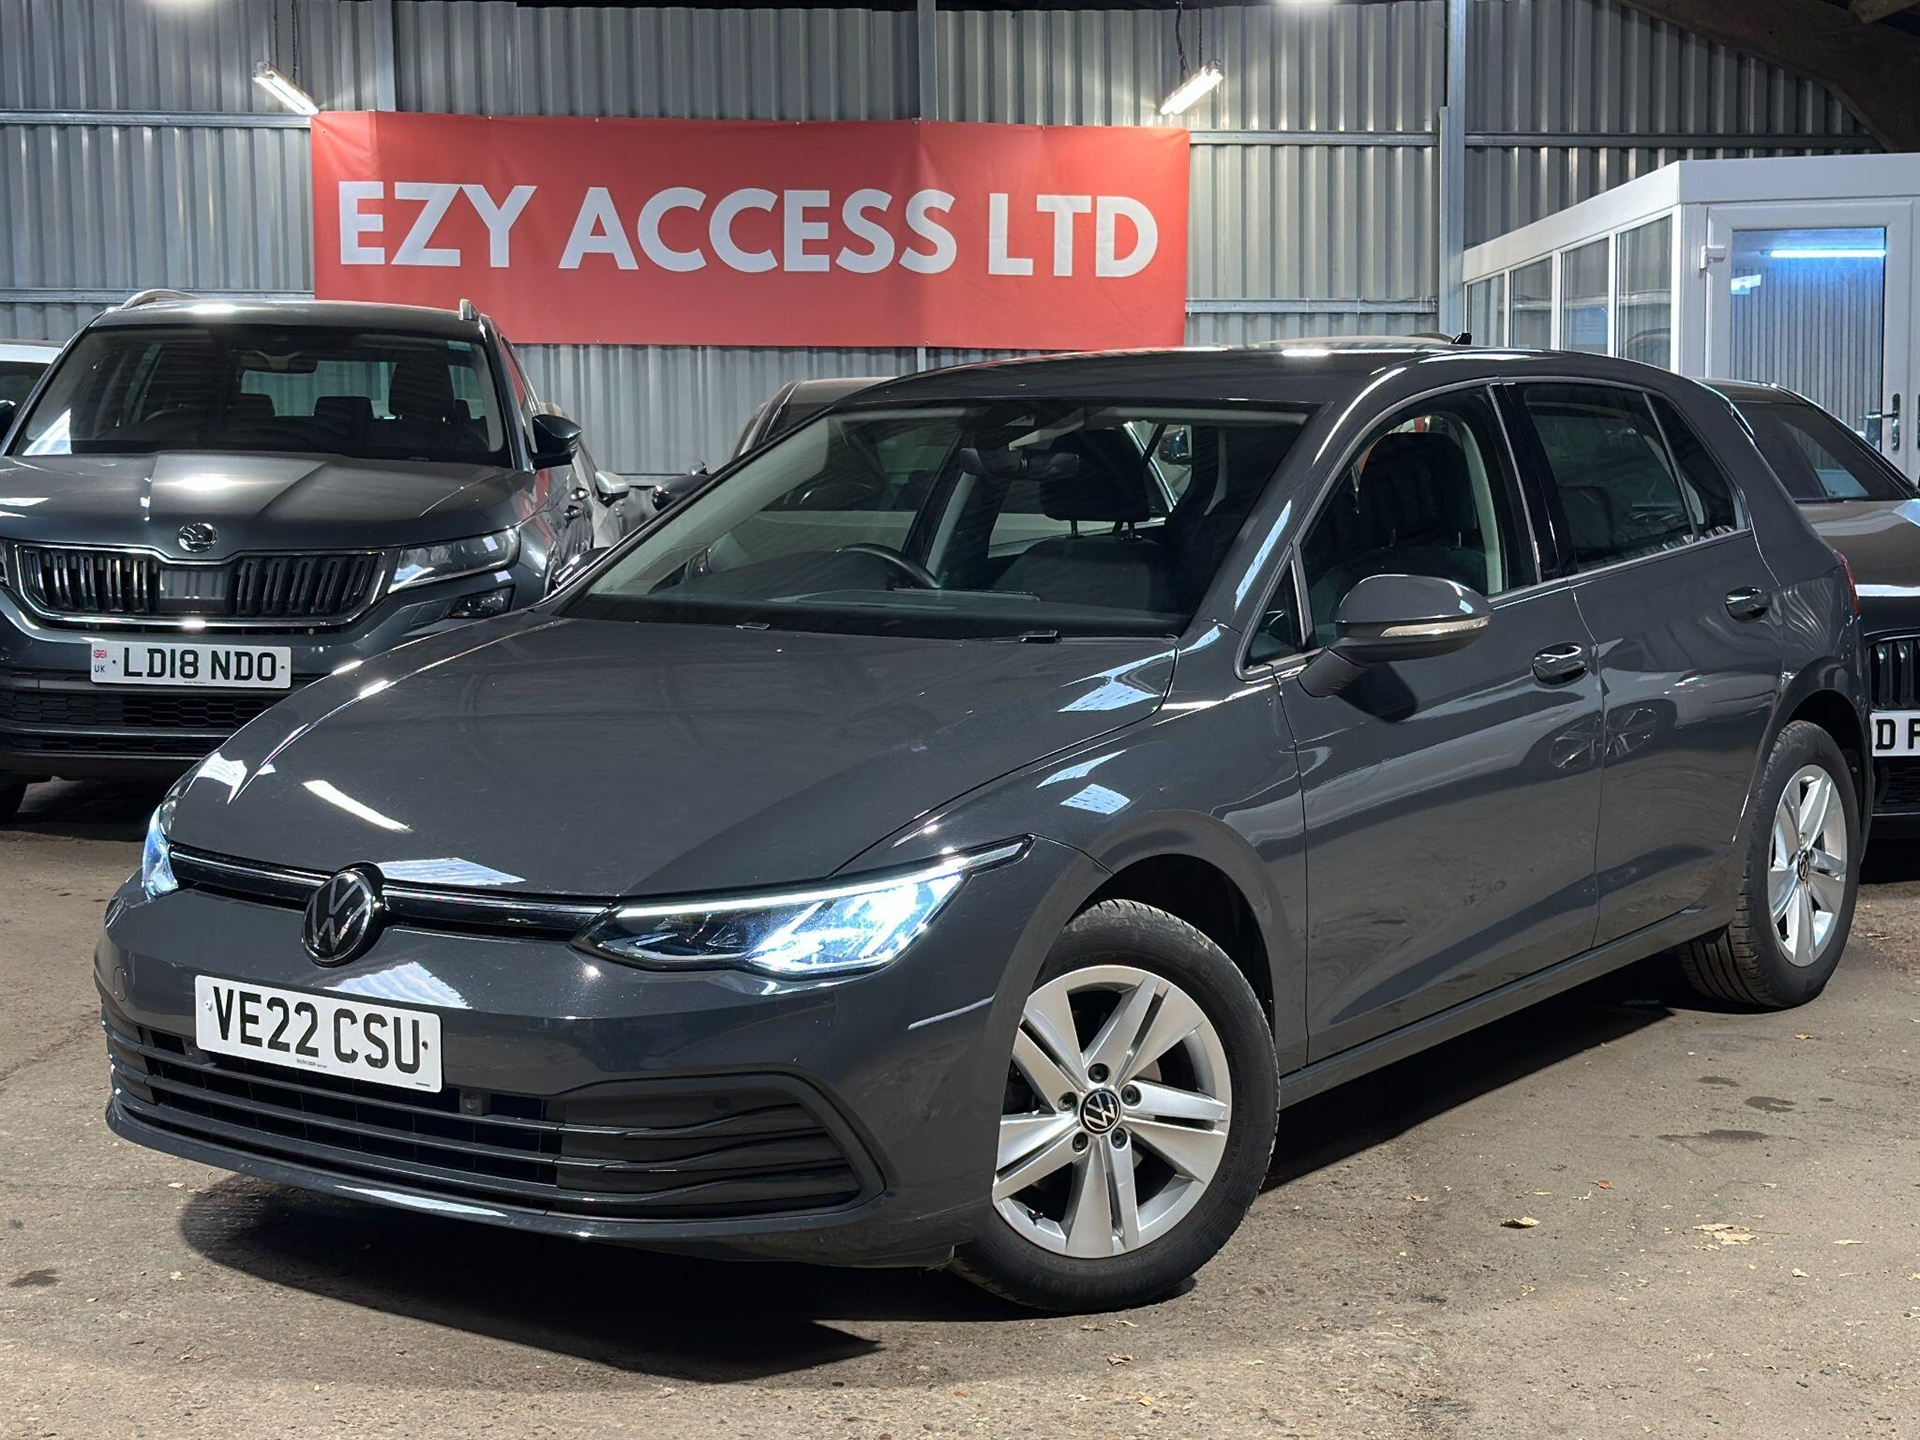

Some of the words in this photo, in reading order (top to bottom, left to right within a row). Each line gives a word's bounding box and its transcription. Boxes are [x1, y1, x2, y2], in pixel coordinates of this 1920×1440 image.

[338, 180, 537, 268] EZY
[558, 186, 958, 274] ACCESS
[988, 192, 1159, 278] LTD
[93, 664, 106, 674] UK
[123, 647, 199, 680] LD18
[210, 650, 277, 682] NDO
[213, 985, 320, 1058] VE22
[333, 1007, 422, 1075] CSU
